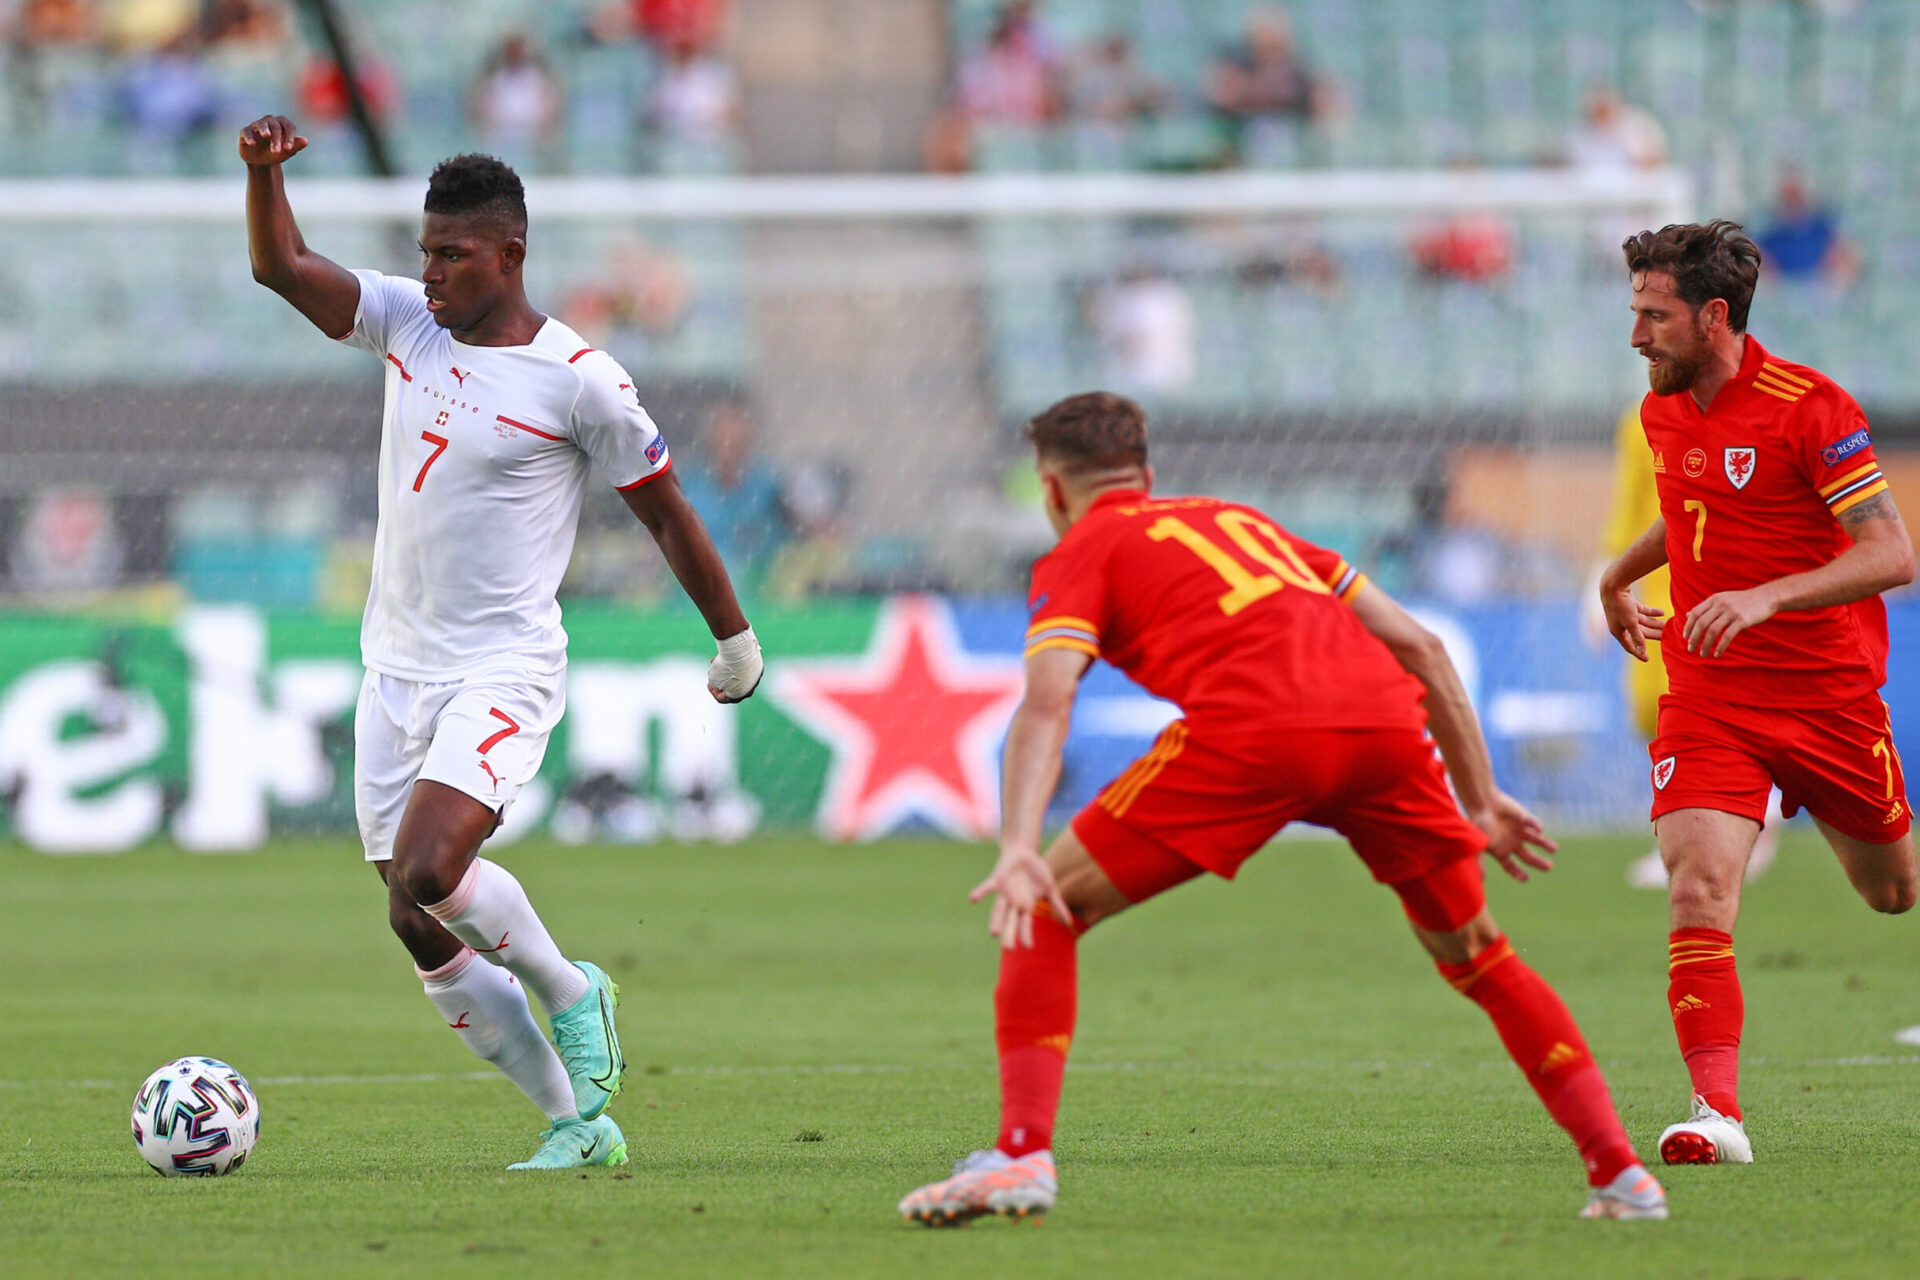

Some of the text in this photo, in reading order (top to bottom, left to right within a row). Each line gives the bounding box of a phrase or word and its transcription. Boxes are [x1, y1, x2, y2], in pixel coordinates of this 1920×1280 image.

[412, 430, 449, 493] 7
[1836, 432, 1870, 456] RESPECT
[1683, 499, 1707, 562] 7
[1145, 510, 1333, 617] 10
[476, 706, 521, 755] 7
[1872, 736, 1894, 800] 7
